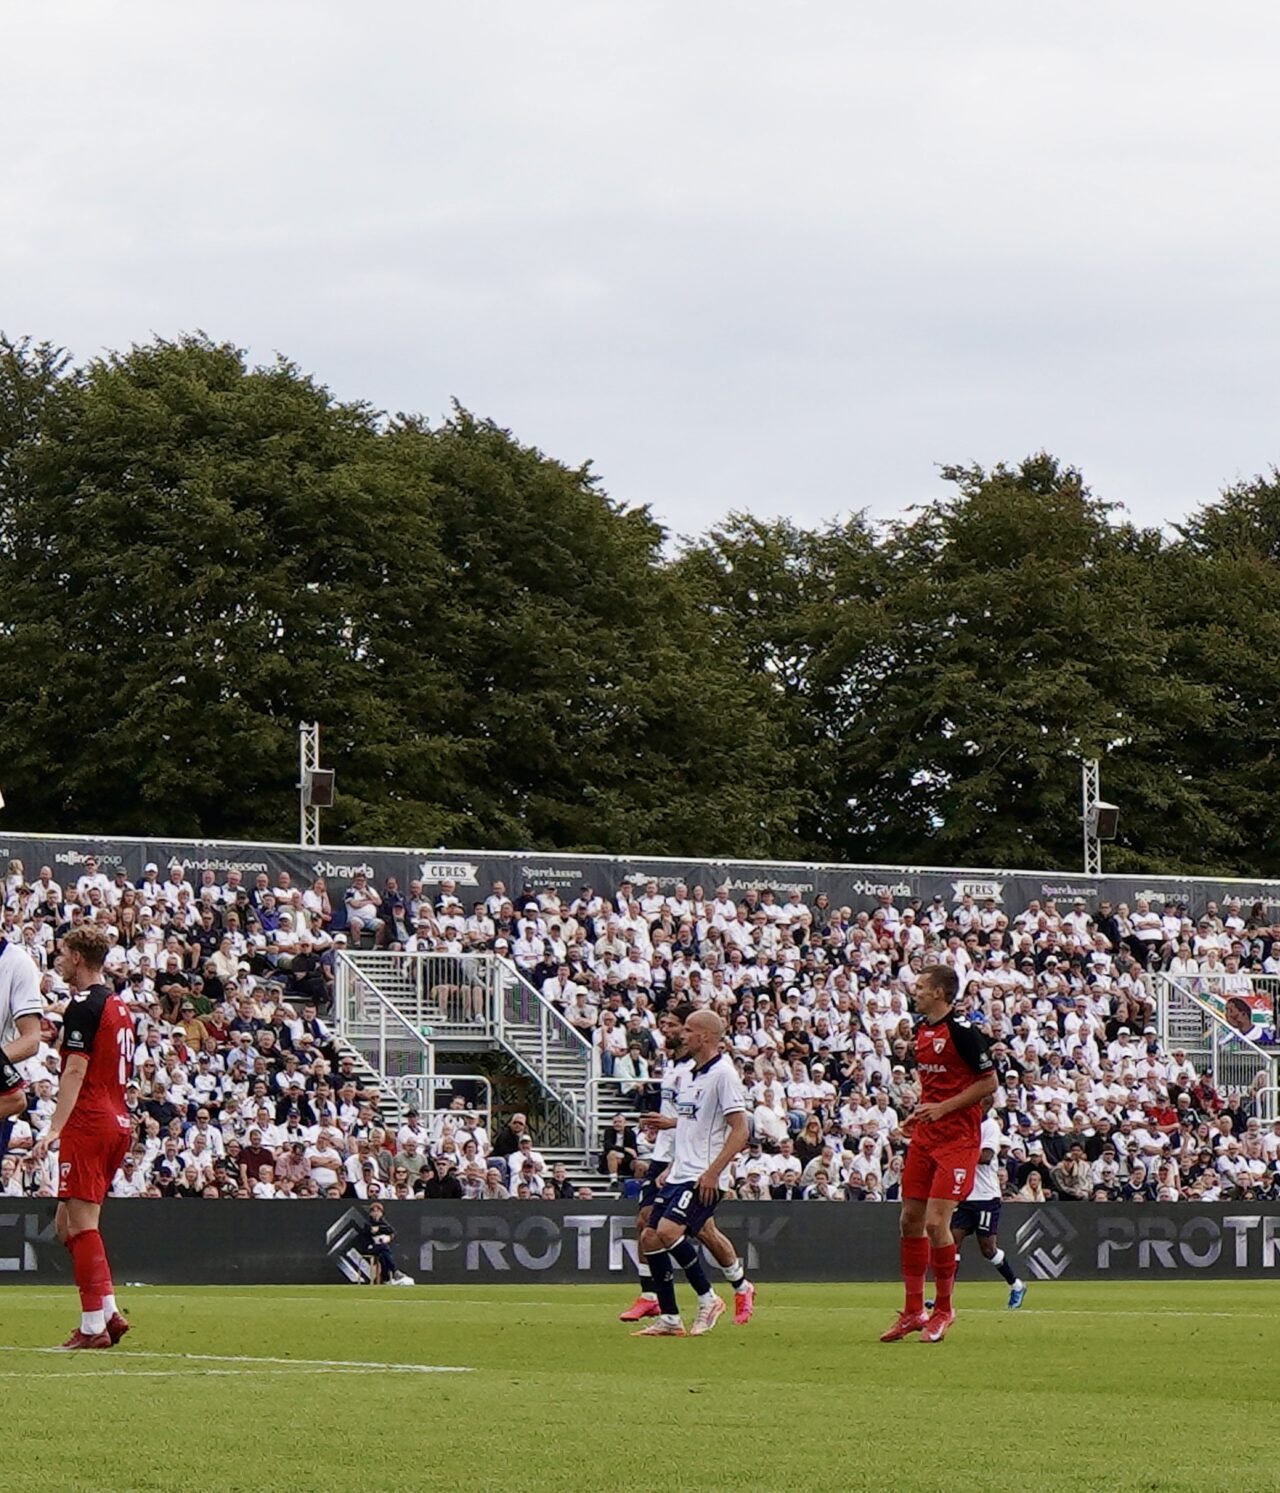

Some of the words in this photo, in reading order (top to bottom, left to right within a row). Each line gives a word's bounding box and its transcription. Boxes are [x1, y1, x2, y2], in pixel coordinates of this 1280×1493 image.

[431, 866, 467, 877] CERES
[963, 884, 994, 895] CERES
[979, 1210, 992, 1232] 11
